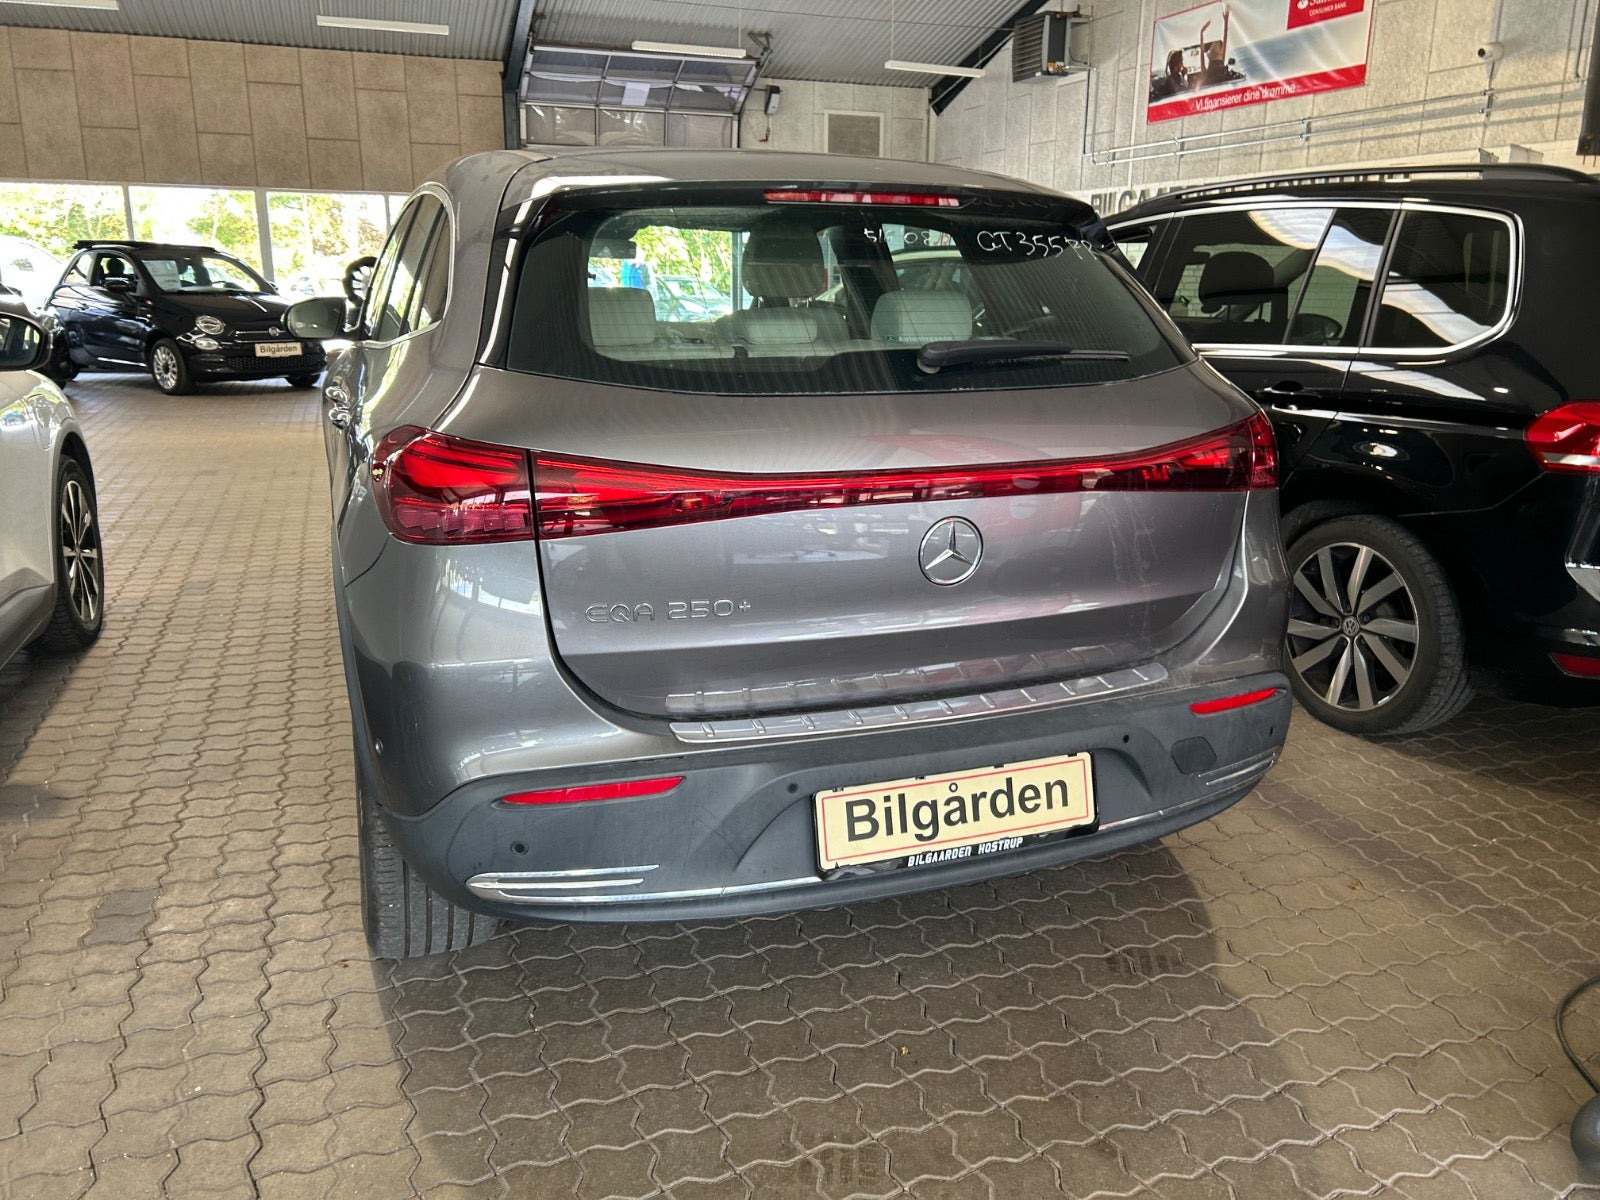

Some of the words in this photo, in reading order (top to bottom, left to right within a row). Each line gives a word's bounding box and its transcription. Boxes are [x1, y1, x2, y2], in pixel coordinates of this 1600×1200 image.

[1309, 6, 1333, 16] CONSUMER
[1334, 2, 1347, 10] BANK
[1204, 93, 1243, 109] finansierer
[1243, 88, 1260, 100] dine
[260, 345, 297, 354] Bilgården
[584, 602, 656, 624] EQA
[667, 599, 752, 620] 250+
[845, 777, 1069, 842] Bilgården
[907, 846, 972, 868] BILGAARDEN
[977, 836, 1024, 855] HOSTRUP
